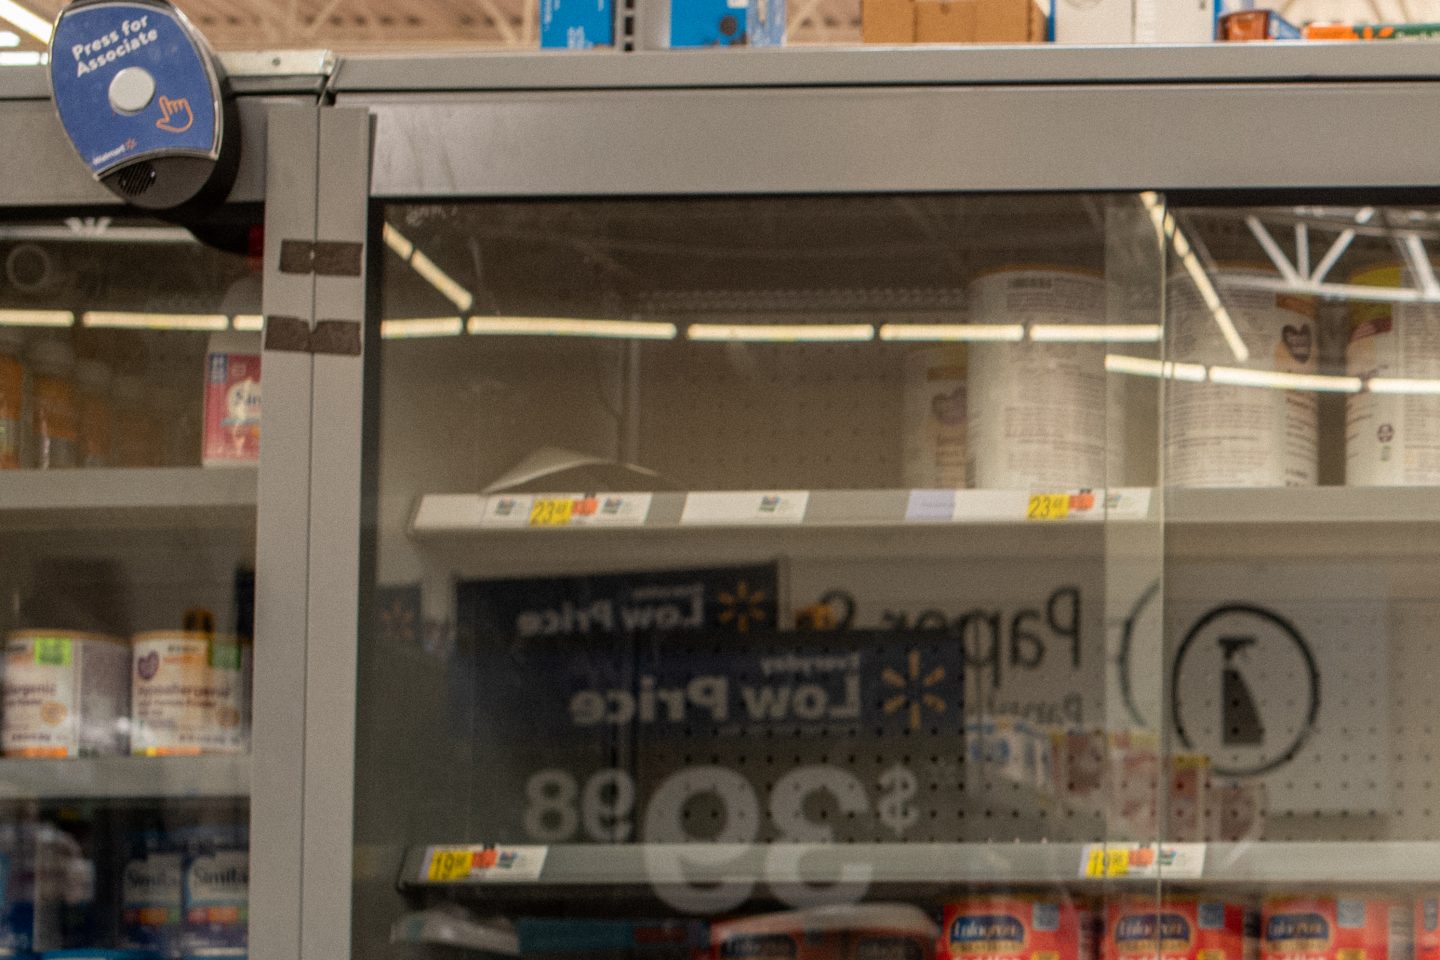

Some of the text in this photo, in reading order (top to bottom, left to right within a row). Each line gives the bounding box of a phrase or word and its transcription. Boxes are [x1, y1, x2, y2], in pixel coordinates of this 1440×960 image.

[72, 15, 149, 61] Press for
[76, 29, 158, 78] Associate
